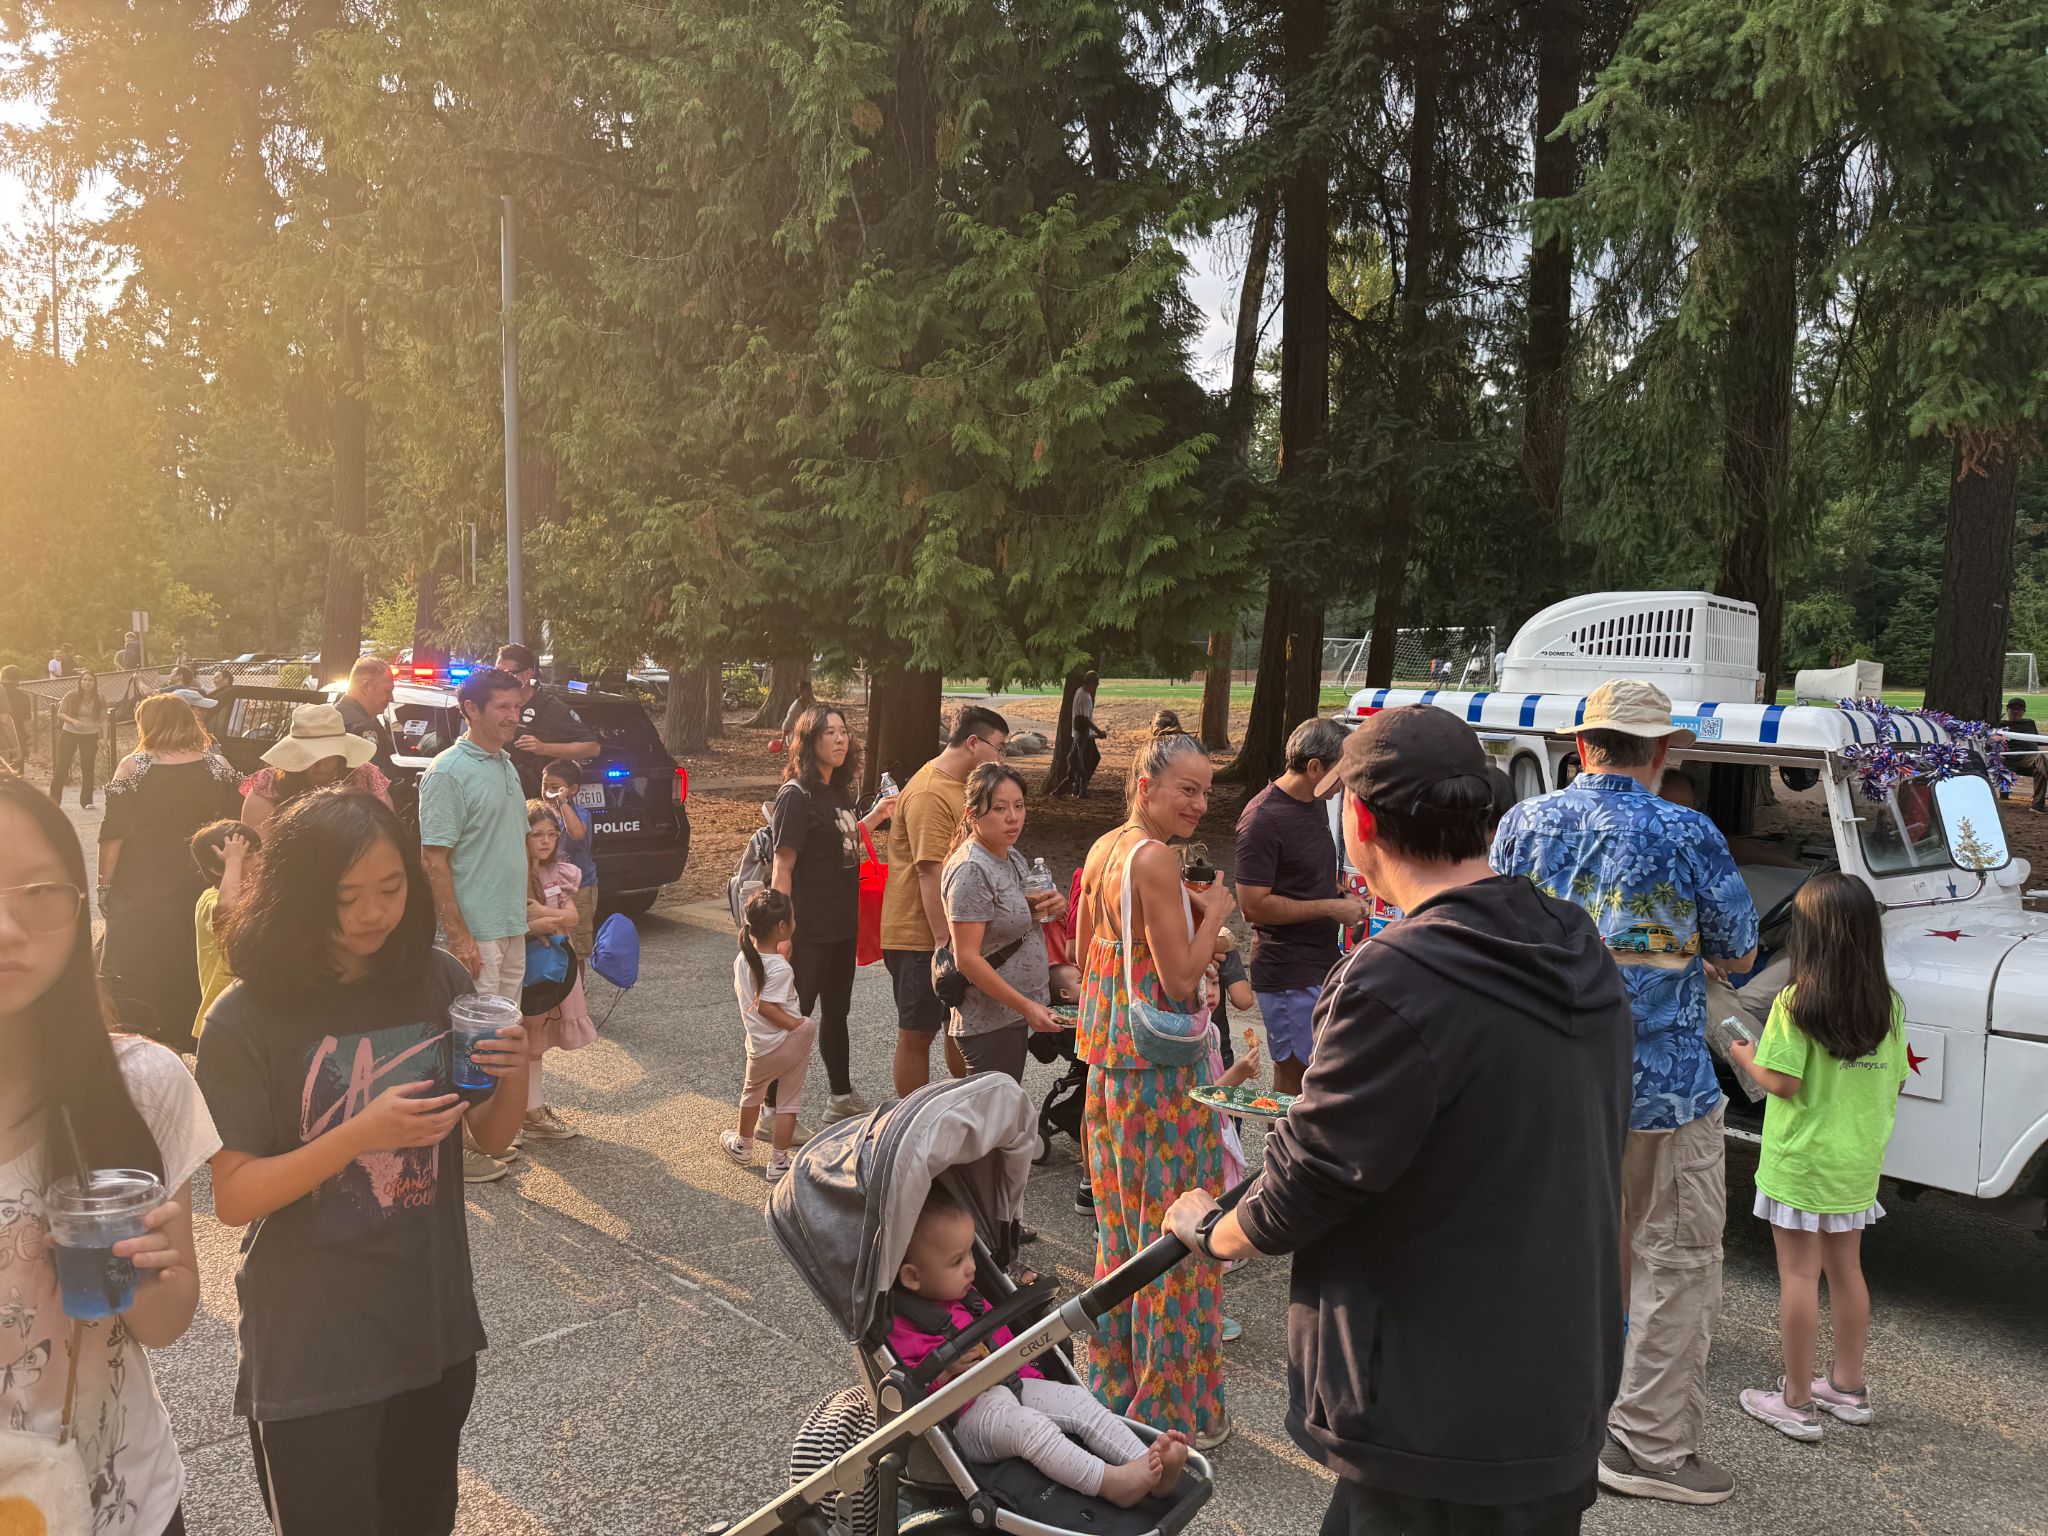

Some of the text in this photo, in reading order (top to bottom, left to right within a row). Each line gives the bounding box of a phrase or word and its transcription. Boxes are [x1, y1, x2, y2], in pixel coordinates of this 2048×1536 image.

[594, 821, 640, 833] POLICE
[383, 1175, 433, 1197] ORANG
[1020, 1332, 1053, 1357] CRUZ
